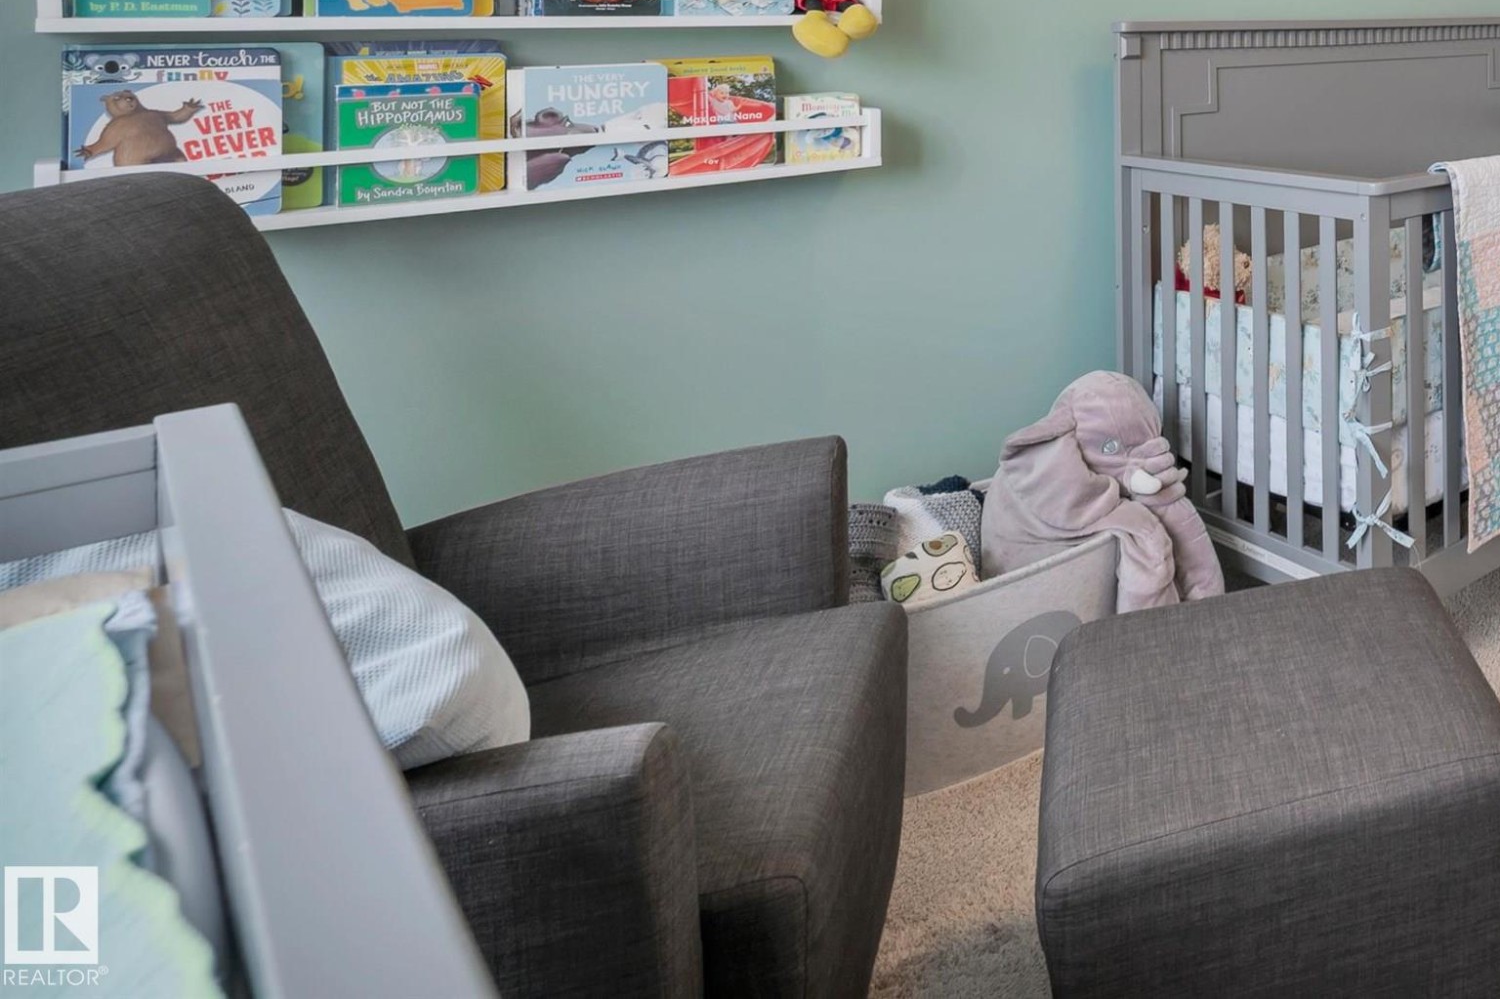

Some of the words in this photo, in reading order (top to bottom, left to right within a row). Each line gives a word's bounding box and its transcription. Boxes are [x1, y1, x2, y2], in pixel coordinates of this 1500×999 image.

[89, 2, 107, 12] by
[110, 2, 121, 11] P.
[124, 2, 138, 11] D.
[141, 2, 198, 11] Eastman
[147, 54, 191, 67] NEVER
[193, 49, 259, 67] touch
[260, 54, 276, 64] THE
[574, 74, 591, 83] THE
[594, 73, 624, 82] VERY
[547, 81, 650, 103] HUNGRY
[208, 99, 233, 113] THE
[371, 101, 396, 113] BUT
[401, 100, 424, 111] NOT
[431, 98, 454, 110] THE
[573, 99, 625, 117] BEAR
[193, 109, 255, 135] VERY
[357, 109, 463, 127] HIPPOPOTAMUS
[682, 115, 706, 125] Max
[709, 114, 731, 122] and
[734, 112, 763, 121] Nana
[183, 127, 277, 161] CLEVER
[357, 190, 370, 201] by
[373, 186, 414, 199] Sandra
[415, 182, 462, 196] Boynton
